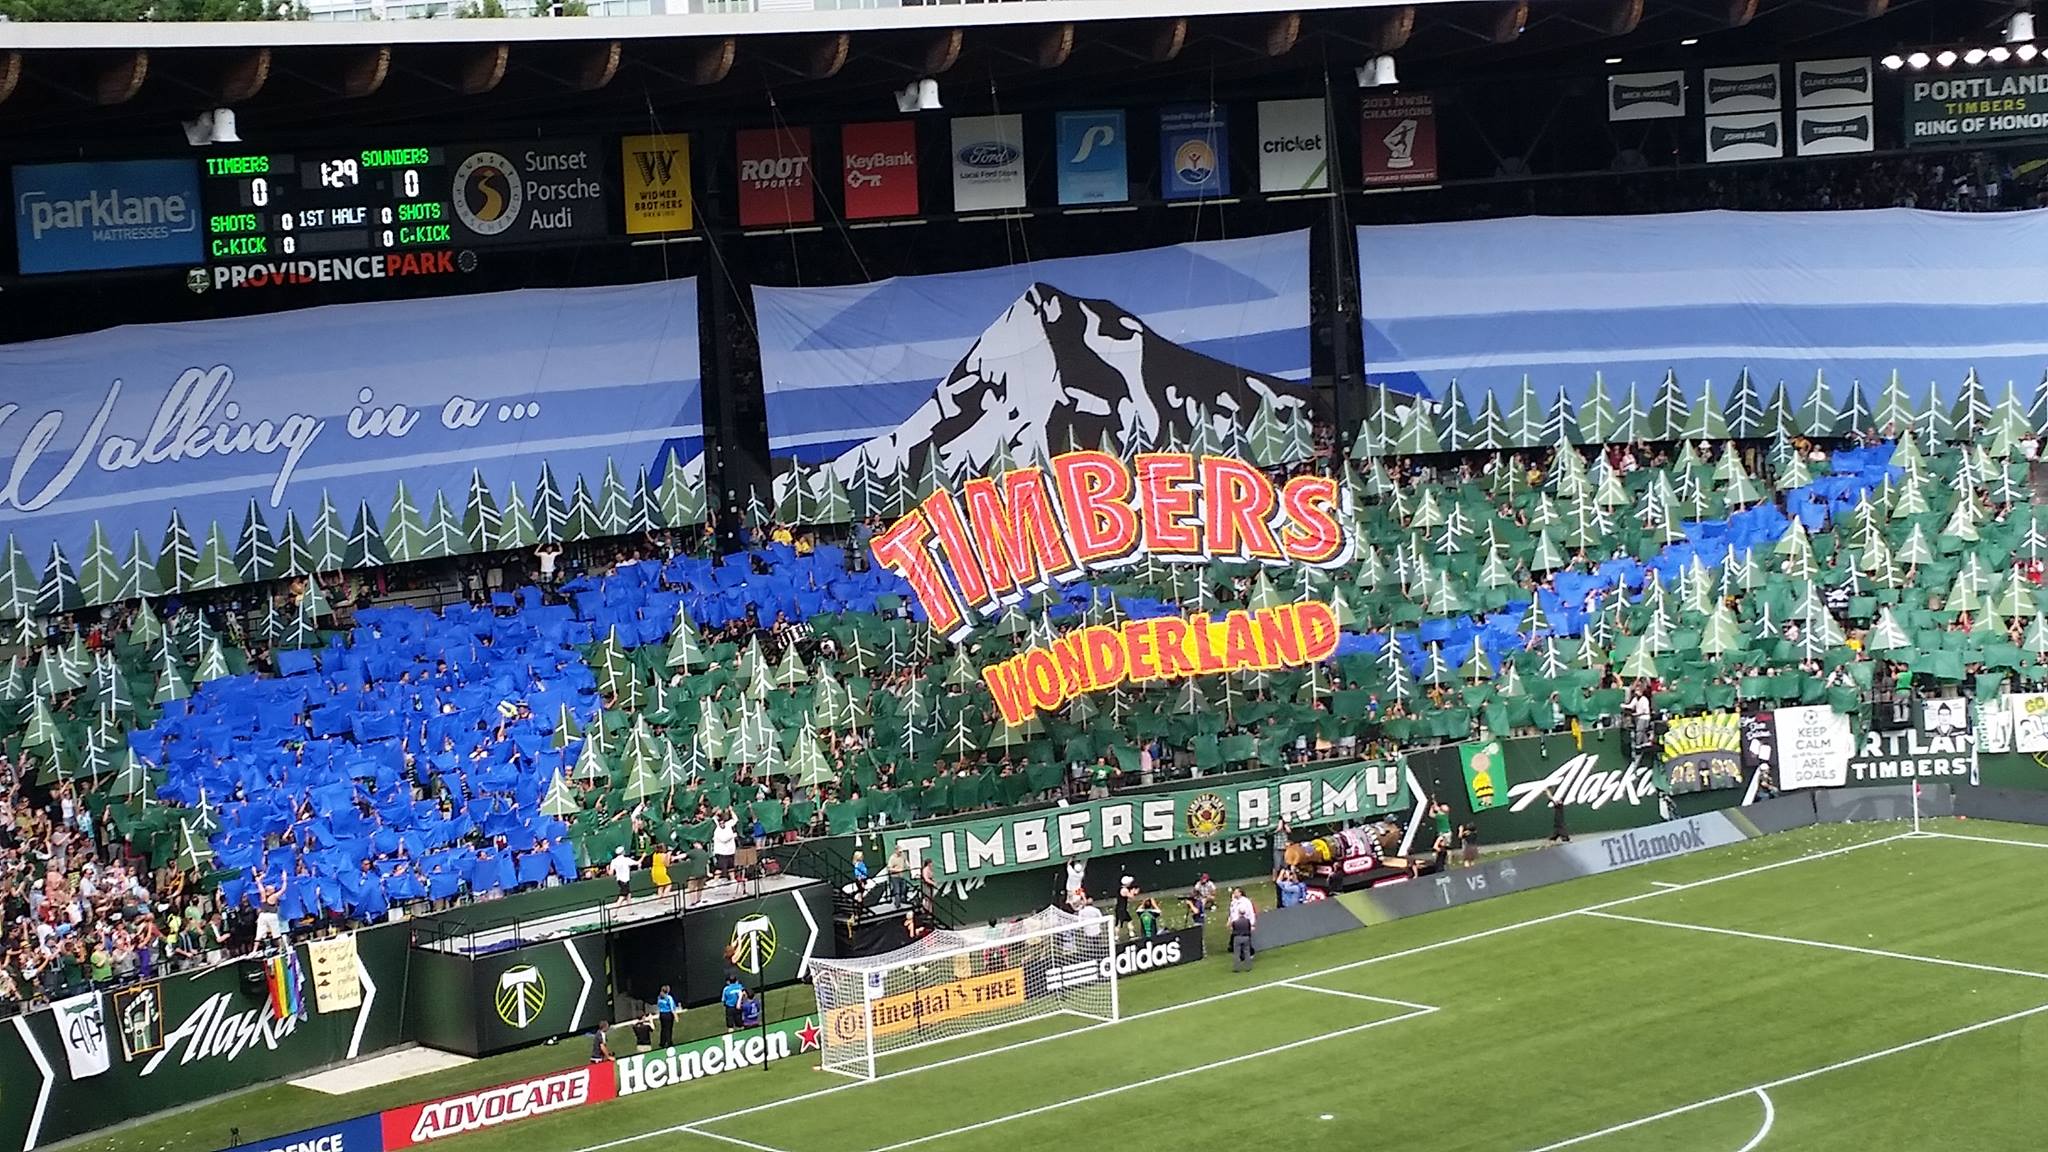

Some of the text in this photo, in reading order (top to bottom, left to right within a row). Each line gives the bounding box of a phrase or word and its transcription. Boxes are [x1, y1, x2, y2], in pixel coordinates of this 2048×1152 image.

[1914, 74, 2048, 102] PORTLAND
[1363, 106, 1432, 119] CHAMPIONS
[1945, 99, 2026, 115] TIMBERS
[1915, 120, 1958, 136] RING
[1961, 117, 1986, 133] OF
[1264, 134, 1322, 154] cricket
[206, 155, 270, 176] TIMBERS
[361, 148, 429, 168] SOUNDERS
[525, 151, 588, 172] Sunset
[846, 152, 914, 170] KeyBank
[969, 147, 1011, 164] Ford
[320, 158, 359, 188] 1:29
[742, 156, 808, 181] ROOT
[251, 177, 268, 207] 0
[404, 169, 419, 198] 0
[526, 177, 600, 201] Porsche
[754, 178, 801, 190] SPORTS
[639, 189, 677, 200] WIDMER
[31, 188, 186, 240] parklane
[381, 207, 392, 225] 0
[398, 203, 441, 221] SHOTS
[634, 200, 683, 212] BROTHERS
[210, 214, 257, 233] SHOTS
[281, 212, 294, 231] 0
[299, 207, 367, 228] 1ST HALF
[529, 206, 572, 230] Audi
[92, 226, 169, 242] MATTRESSES
[382, 229, 394, 248] 0
[399, 225, 451, 244] C.KICK
[212, 236, 268, 257] C.KICK
[283, 236, 295, 255] 0
[0, 363, 326, 512] Walking
[346, 386, 420, 439] in
[870, 450, 1348, 638] TIMBERS
[982, 600, 1341, 728] WONDERLAND
[1797, 726, 1828, 738] KEEP
[1795, 738, 1832, 750] CALM
[1850, 727, 1977, 759] RTLAN
[1802, 757, 1825, 769] ARE
[1851, 757, 1967, 780] TIMBERS
[1506, 753, 1657, 812] Alaska
[1795, 769, 1837, 782] GOALS
[896, 799, 1175, 879] TIMBERS
[1237, 766, 1398, 831] ARMY
[1164, 833, 1268, 862] TIMBERS
[1601, 819, 1705, 866] Tillamook
[1466, 874, 1487, 890] VS
[1099, 937, 1181, 978] adidas
[971, 977, 1017, 1004] TIRE
[138, 992, 299, 1077] Alaska
[616, 1030, 791, 1097] Heineken
[414, 1072, 588, 1138] ADVOCARE
